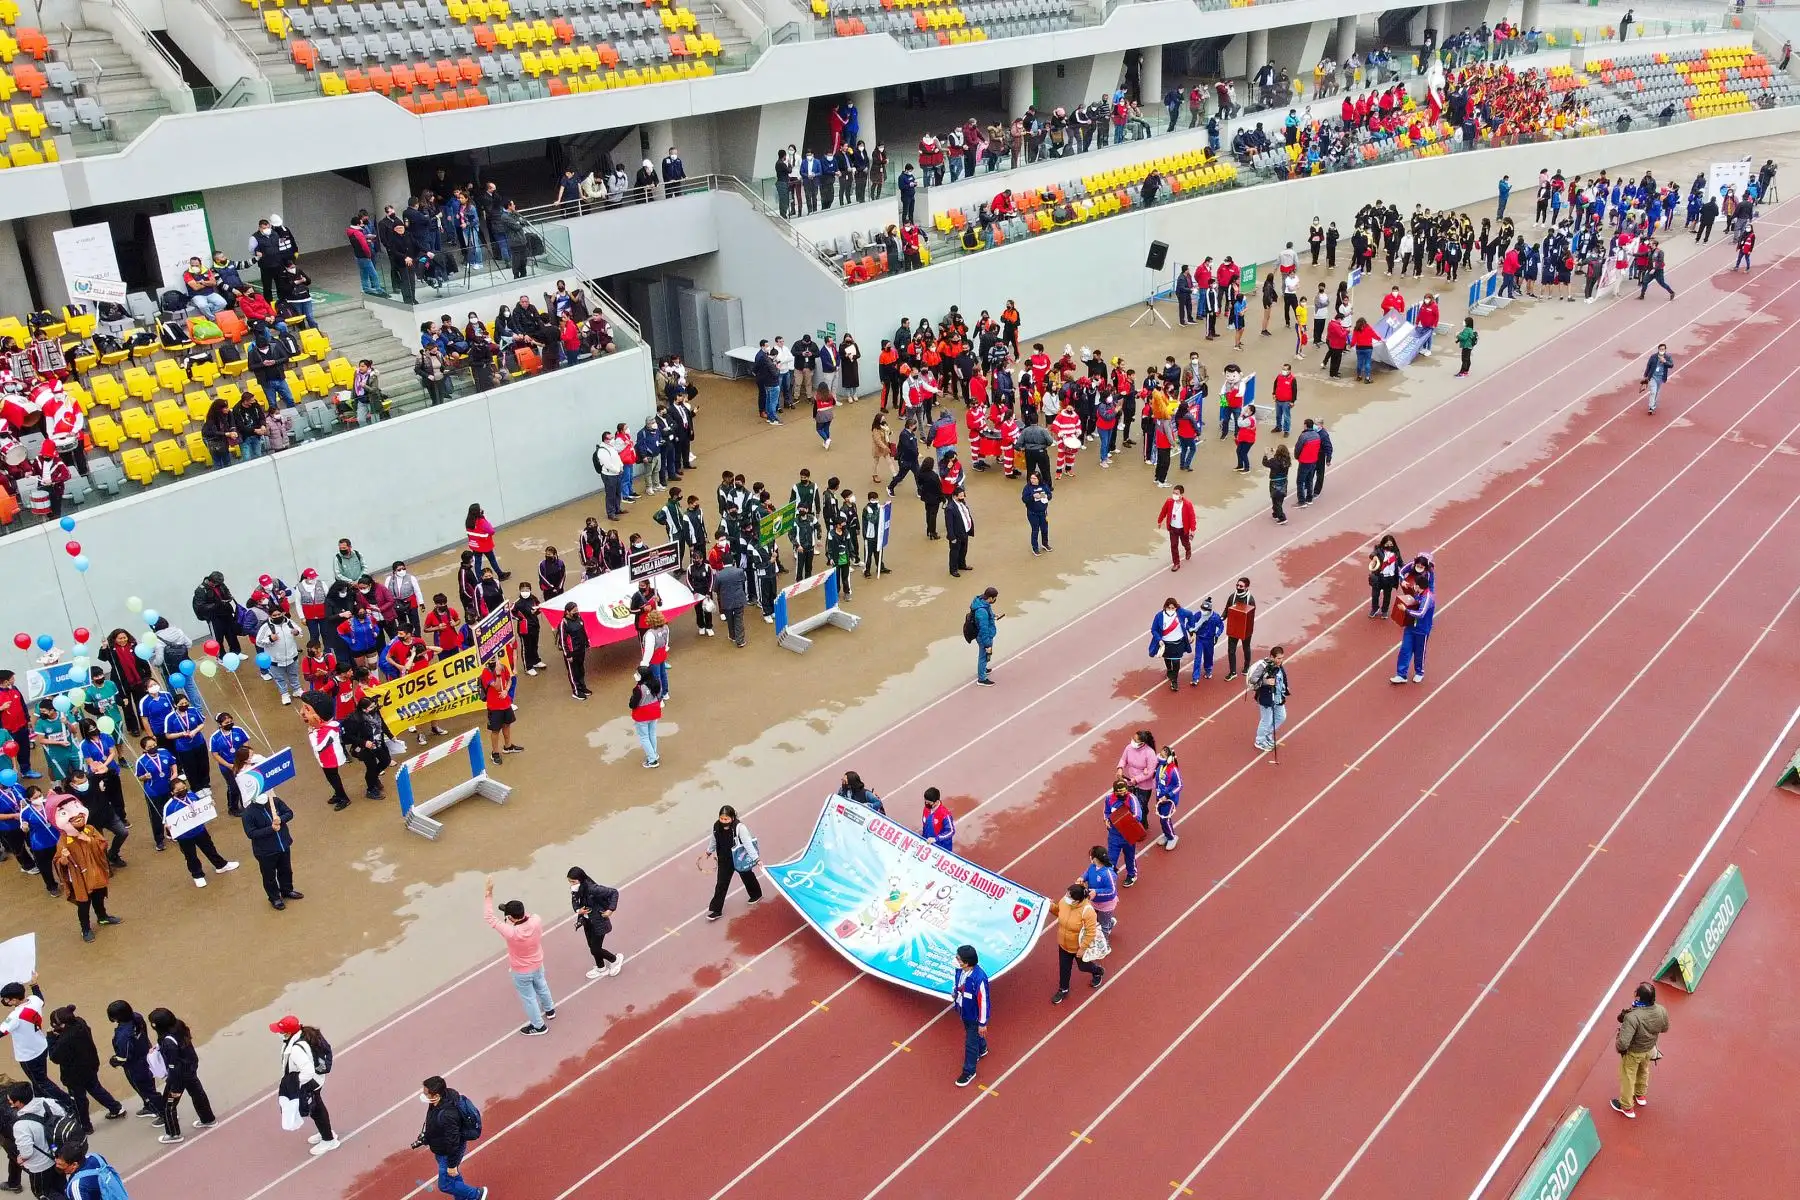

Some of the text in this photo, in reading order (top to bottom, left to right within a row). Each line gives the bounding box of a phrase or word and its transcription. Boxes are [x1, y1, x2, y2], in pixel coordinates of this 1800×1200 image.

[397, 670, 438, 699] JOSE
[265, 761, 291, 778] UGEL 07
[867, 817, 901, 847] CEBE
[915, 846, 933, 862] 13
